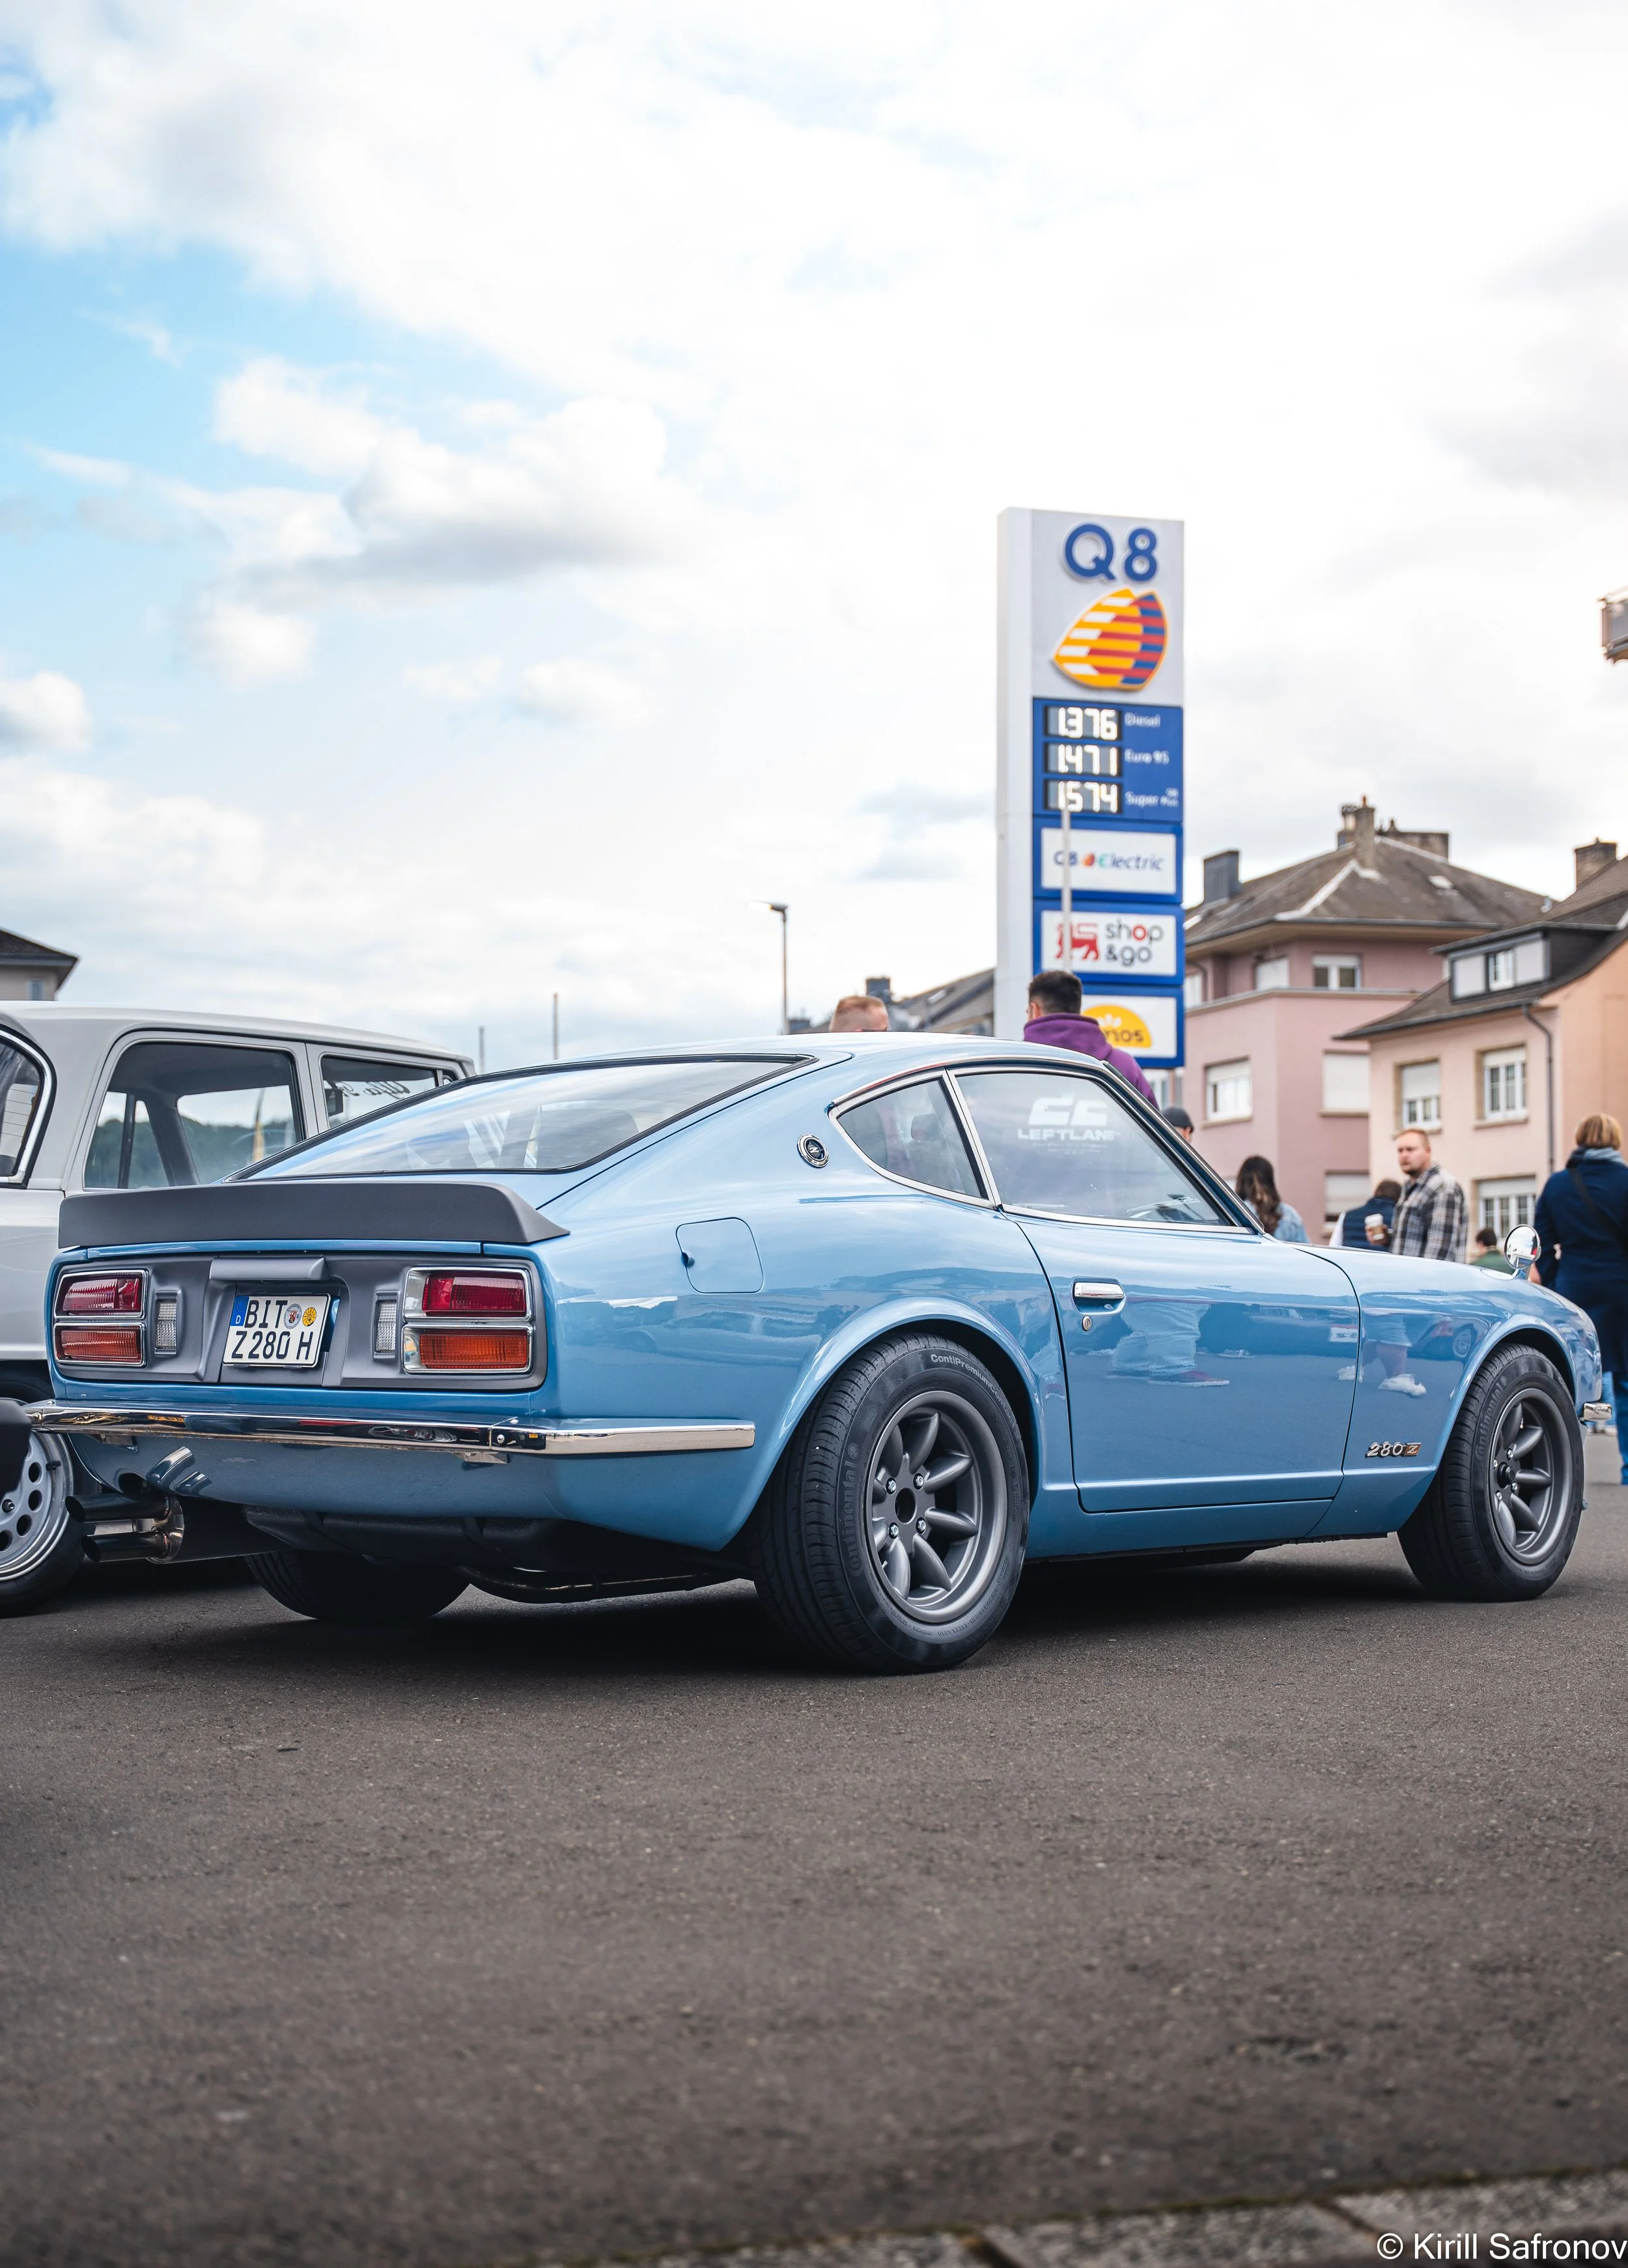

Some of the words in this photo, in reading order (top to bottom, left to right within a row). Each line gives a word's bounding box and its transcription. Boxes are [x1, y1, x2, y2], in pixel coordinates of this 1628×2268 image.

[1065, 523, 1157, 582] Q8
[1125, 712, 1160, 728] Diesel
[1125, 748, 1152, 763] Euro
[1153, 750, 1170, 765] 95
[1125, 791, 1158, 808] Super
[1106, 916, 1164, 945] shop
[1106, 1029, 1144, 1043] nos
[235, 1315, 241, 1324] D
[244, 1300, 288, 1329] BIT
[296, 1331, 314, 1360] H
